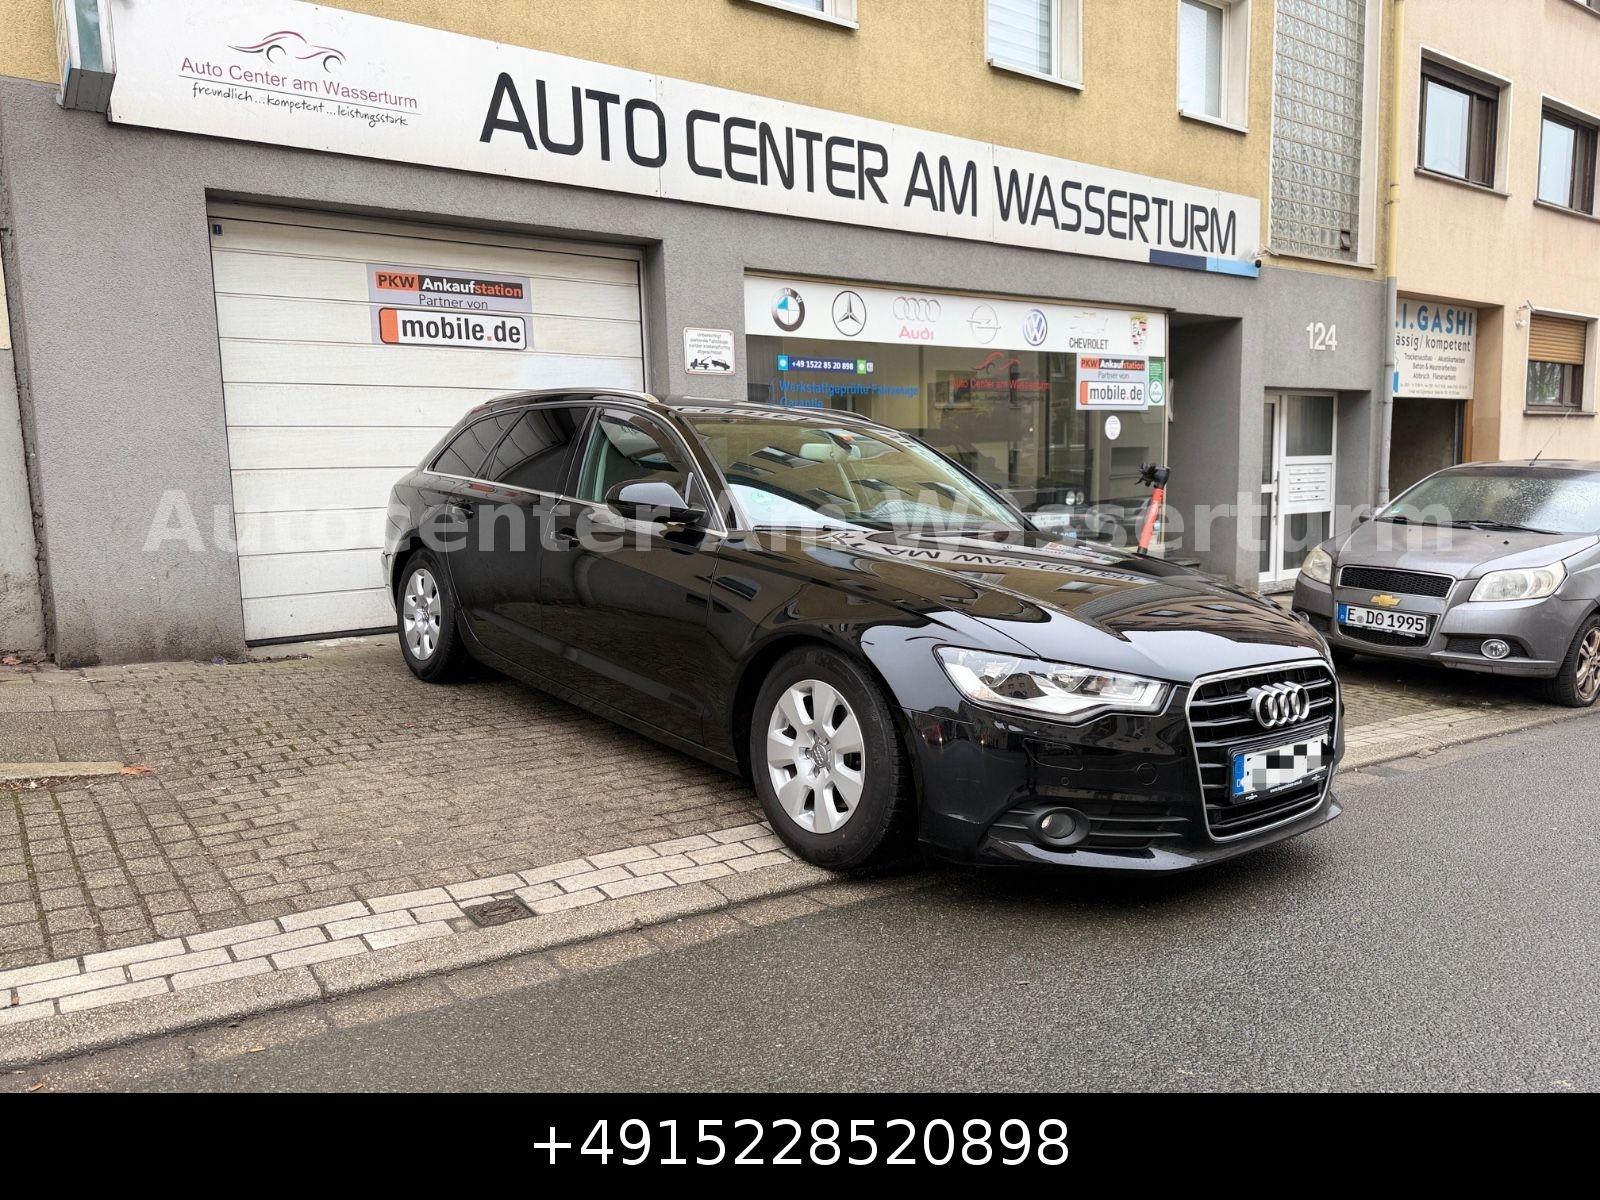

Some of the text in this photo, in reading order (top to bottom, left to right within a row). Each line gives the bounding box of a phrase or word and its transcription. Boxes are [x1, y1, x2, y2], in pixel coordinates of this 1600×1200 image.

[180, 56, 418, 109] Auto Center am Wasserturm
[479, 71, 1238, 256] AUTO CENTER AM WASSERTURM
[377, 274, 522, 298] PKW Ankaufstation
[418, 294, 489, 310] Partner von
[401, 316, 521, 344] mobile.de
[898, 325, 934, 341] Audi
[1306, 322, 1338, 351] 124
[1069, 337, 1109, 350] CHEVROLET
[1425, 335, 1471, 353] kompetent
[791, 360, 854, 371] +49 1522 85 20 898
[1081, 358, 1098, 369] PKW
[1100, 359, 1145, 371] Ankaufstation
[1098, 371, 1118, 380] Partner
[1090, 385, 1143, 401] mobile.de
[1347, 607, 1356, 622] E
[1387, 613, 1425, 632] 1995
